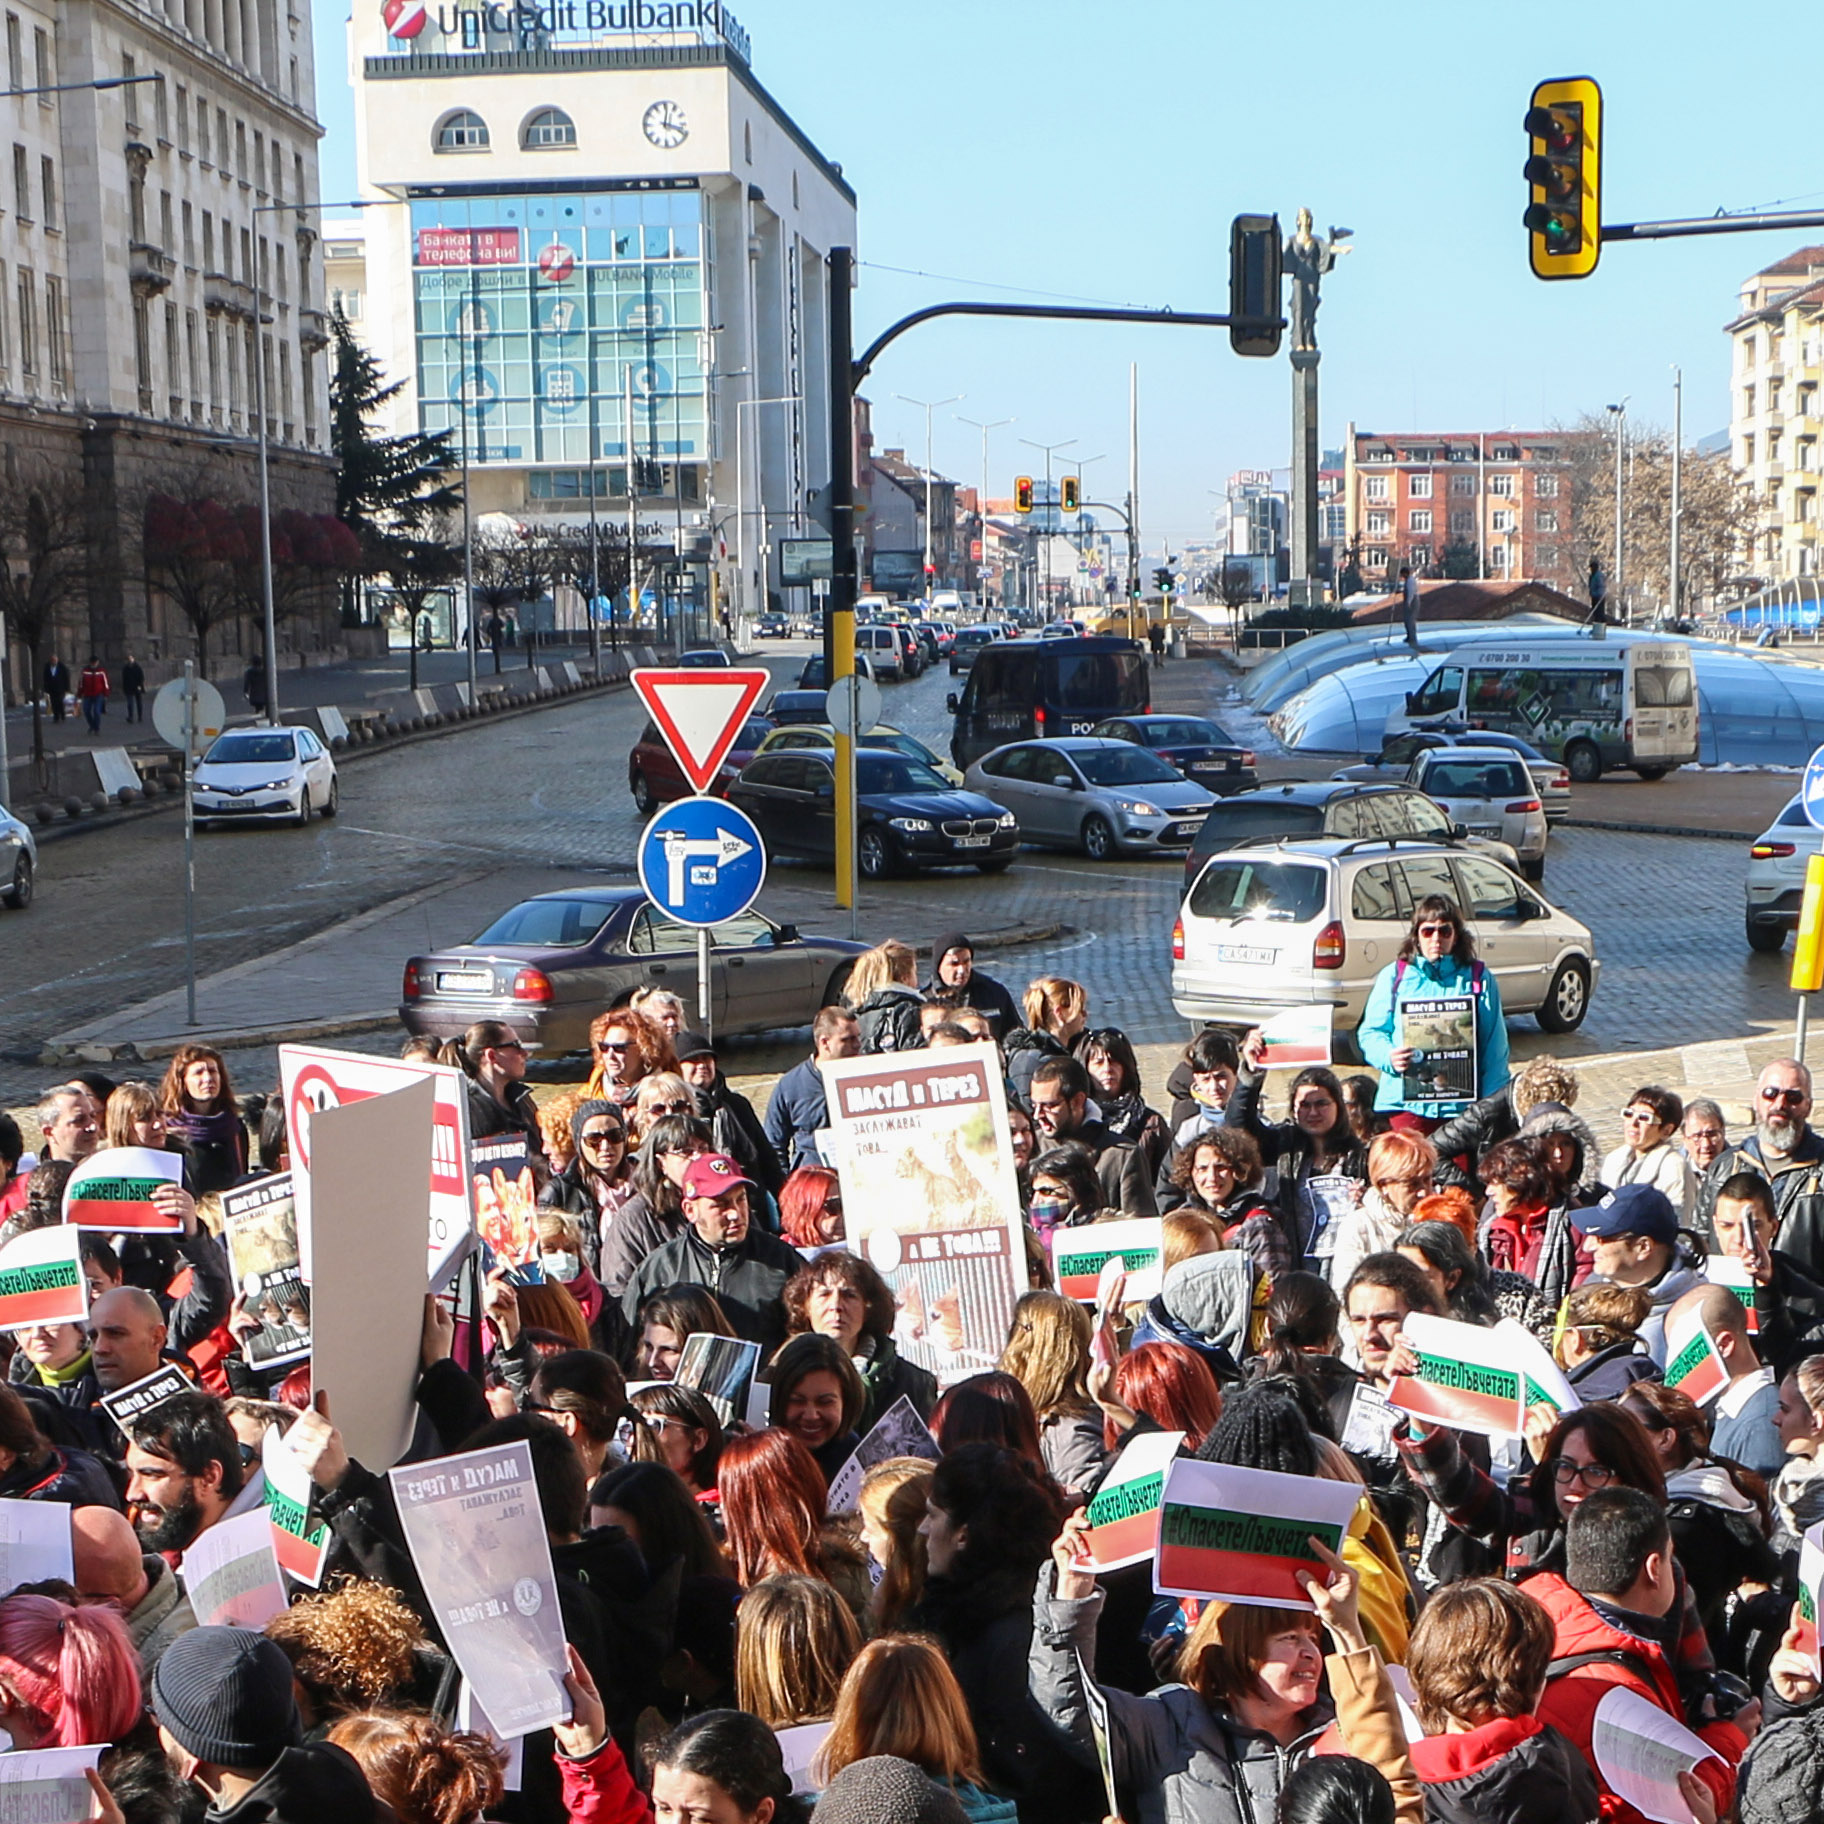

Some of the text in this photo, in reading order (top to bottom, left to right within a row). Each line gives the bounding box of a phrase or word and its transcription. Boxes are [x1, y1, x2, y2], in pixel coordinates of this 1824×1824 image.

[438, 0, 720, 34] UniCredit Bulbank
[652, 267, 694, 280] Mobile
[846, 1080, 910, 1112] МАСУД
[927, 1073, 979, 1103] ТЕРЕЗ
[854, 1115, 922, 1136] ЗАСЛУЖАВАТ
[919, 1237, 941, 1258] НЕ
